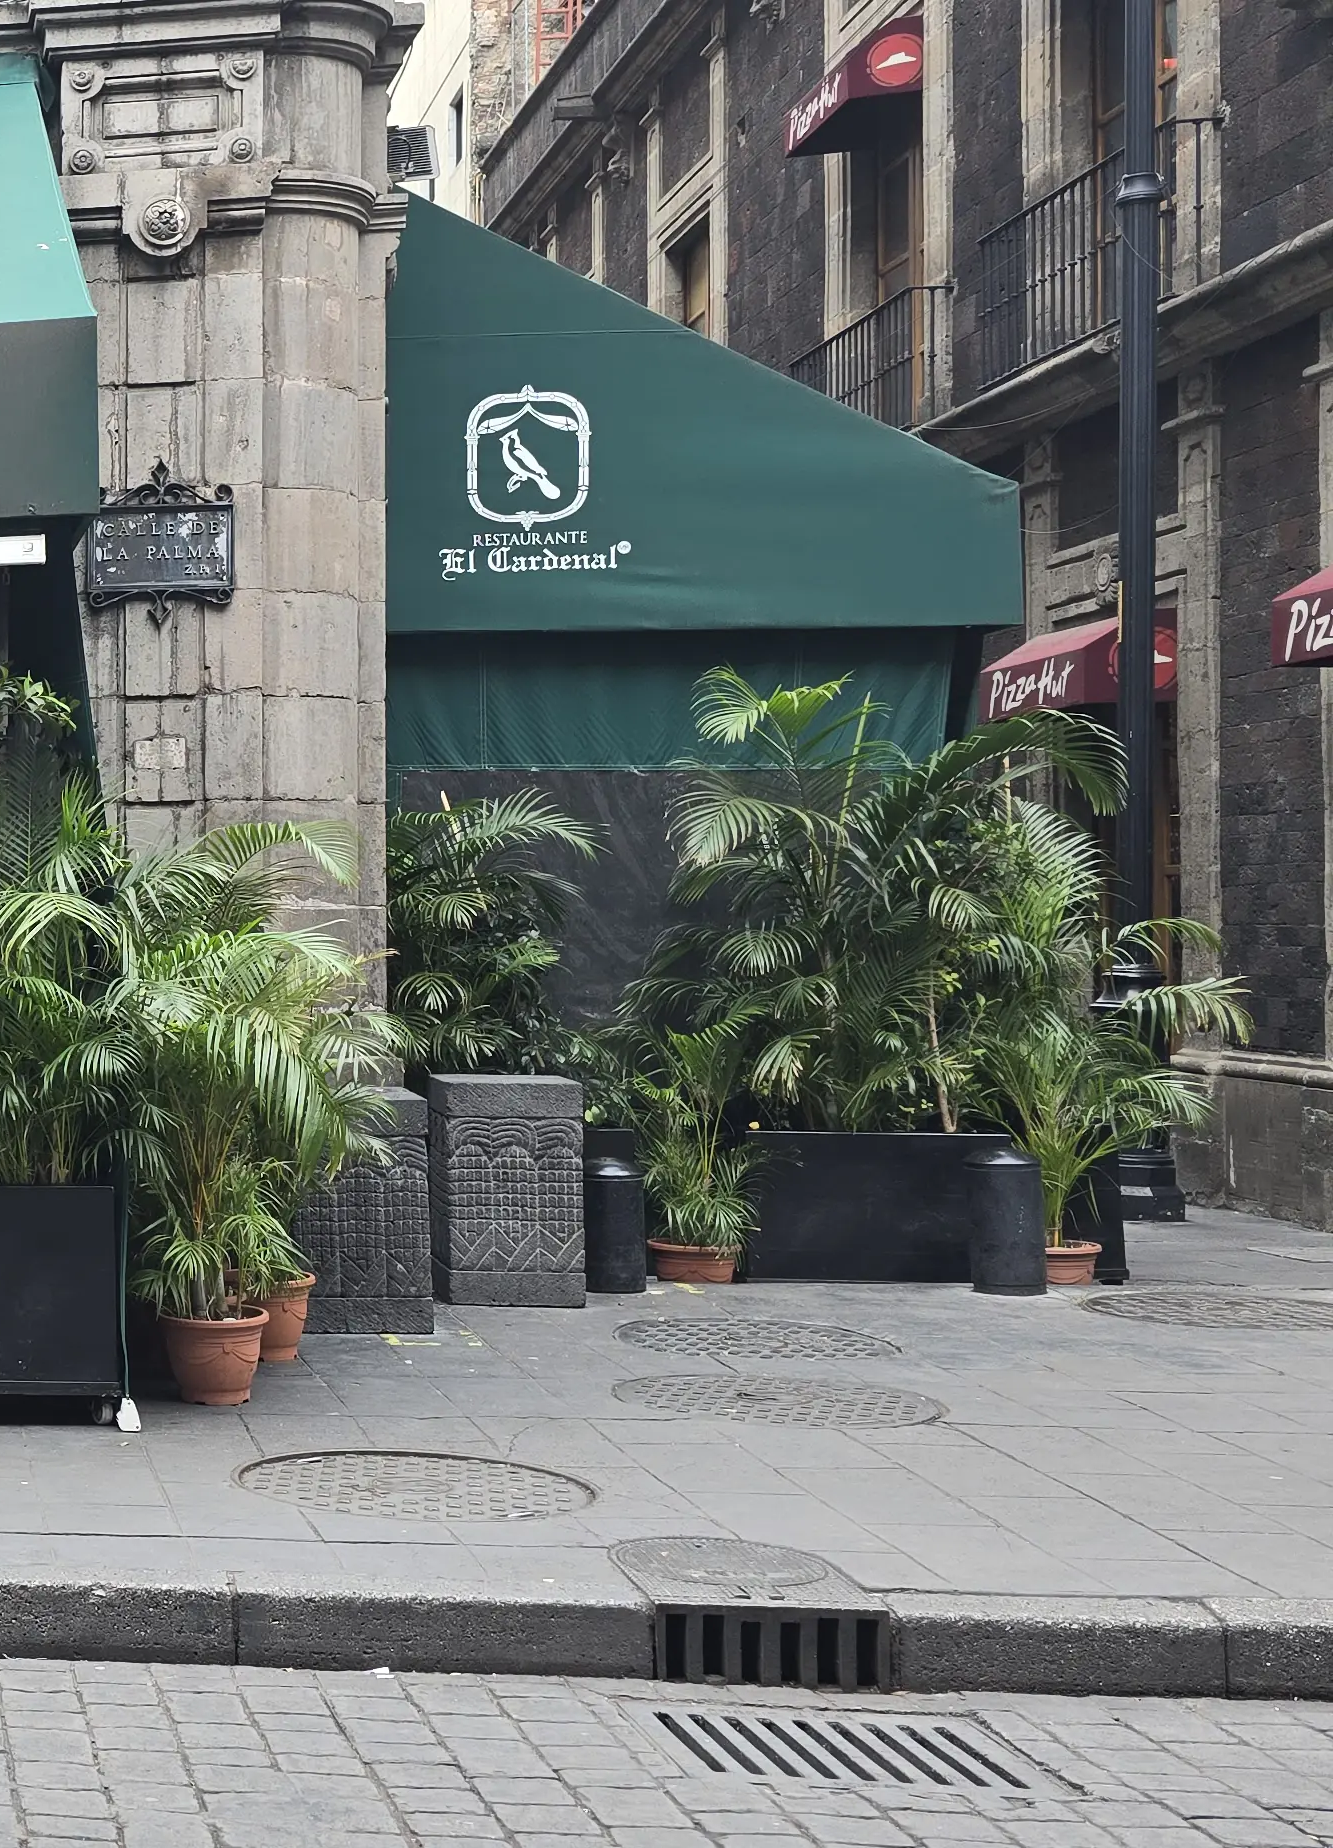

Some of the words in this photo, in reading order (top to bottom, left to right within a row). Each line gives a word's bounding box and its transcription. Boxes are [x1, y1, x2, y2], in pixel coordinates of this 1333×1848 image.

[788, 97, 819, 151] Pizza
[102, 521, 177, 538] CALLE
[191, 520, 222, 535] DE
[473, 530, 588, 548] RESTAURANTE
[101, 546, 130, 562] LA
[146, 544, 220, 561] PALMA
[439, 548, 477, 581] El
[487, 544, 618, 574] Cardenal
[1285, 597, 1333, 662] Piz
[988, 670, 1037, 719] Pizza
[1038, 658, 1075, 705] Hut
